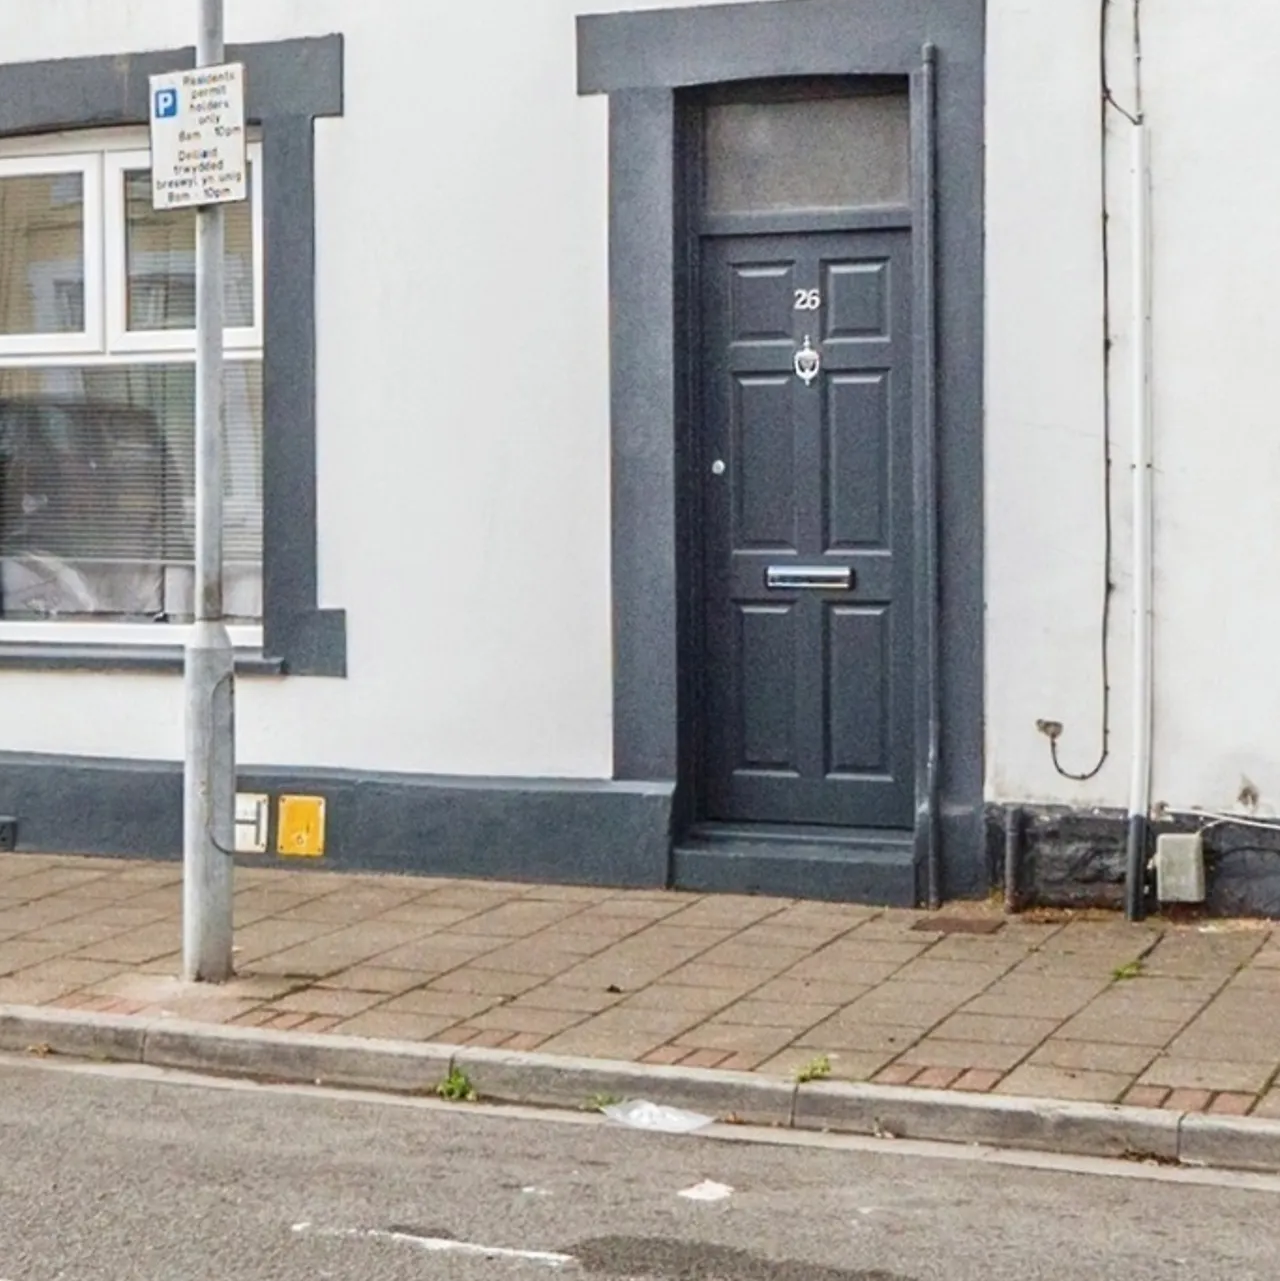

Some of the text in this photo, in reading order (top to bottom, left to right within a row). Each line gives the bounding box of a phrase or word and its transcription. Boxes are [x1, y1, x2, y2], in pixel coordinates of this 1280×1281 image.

[182, 71, 235, 85] Residents
[158, 92, 173, 115] P
[198, 113, 221, 125] only
[794, 289, 820, 310] 26
